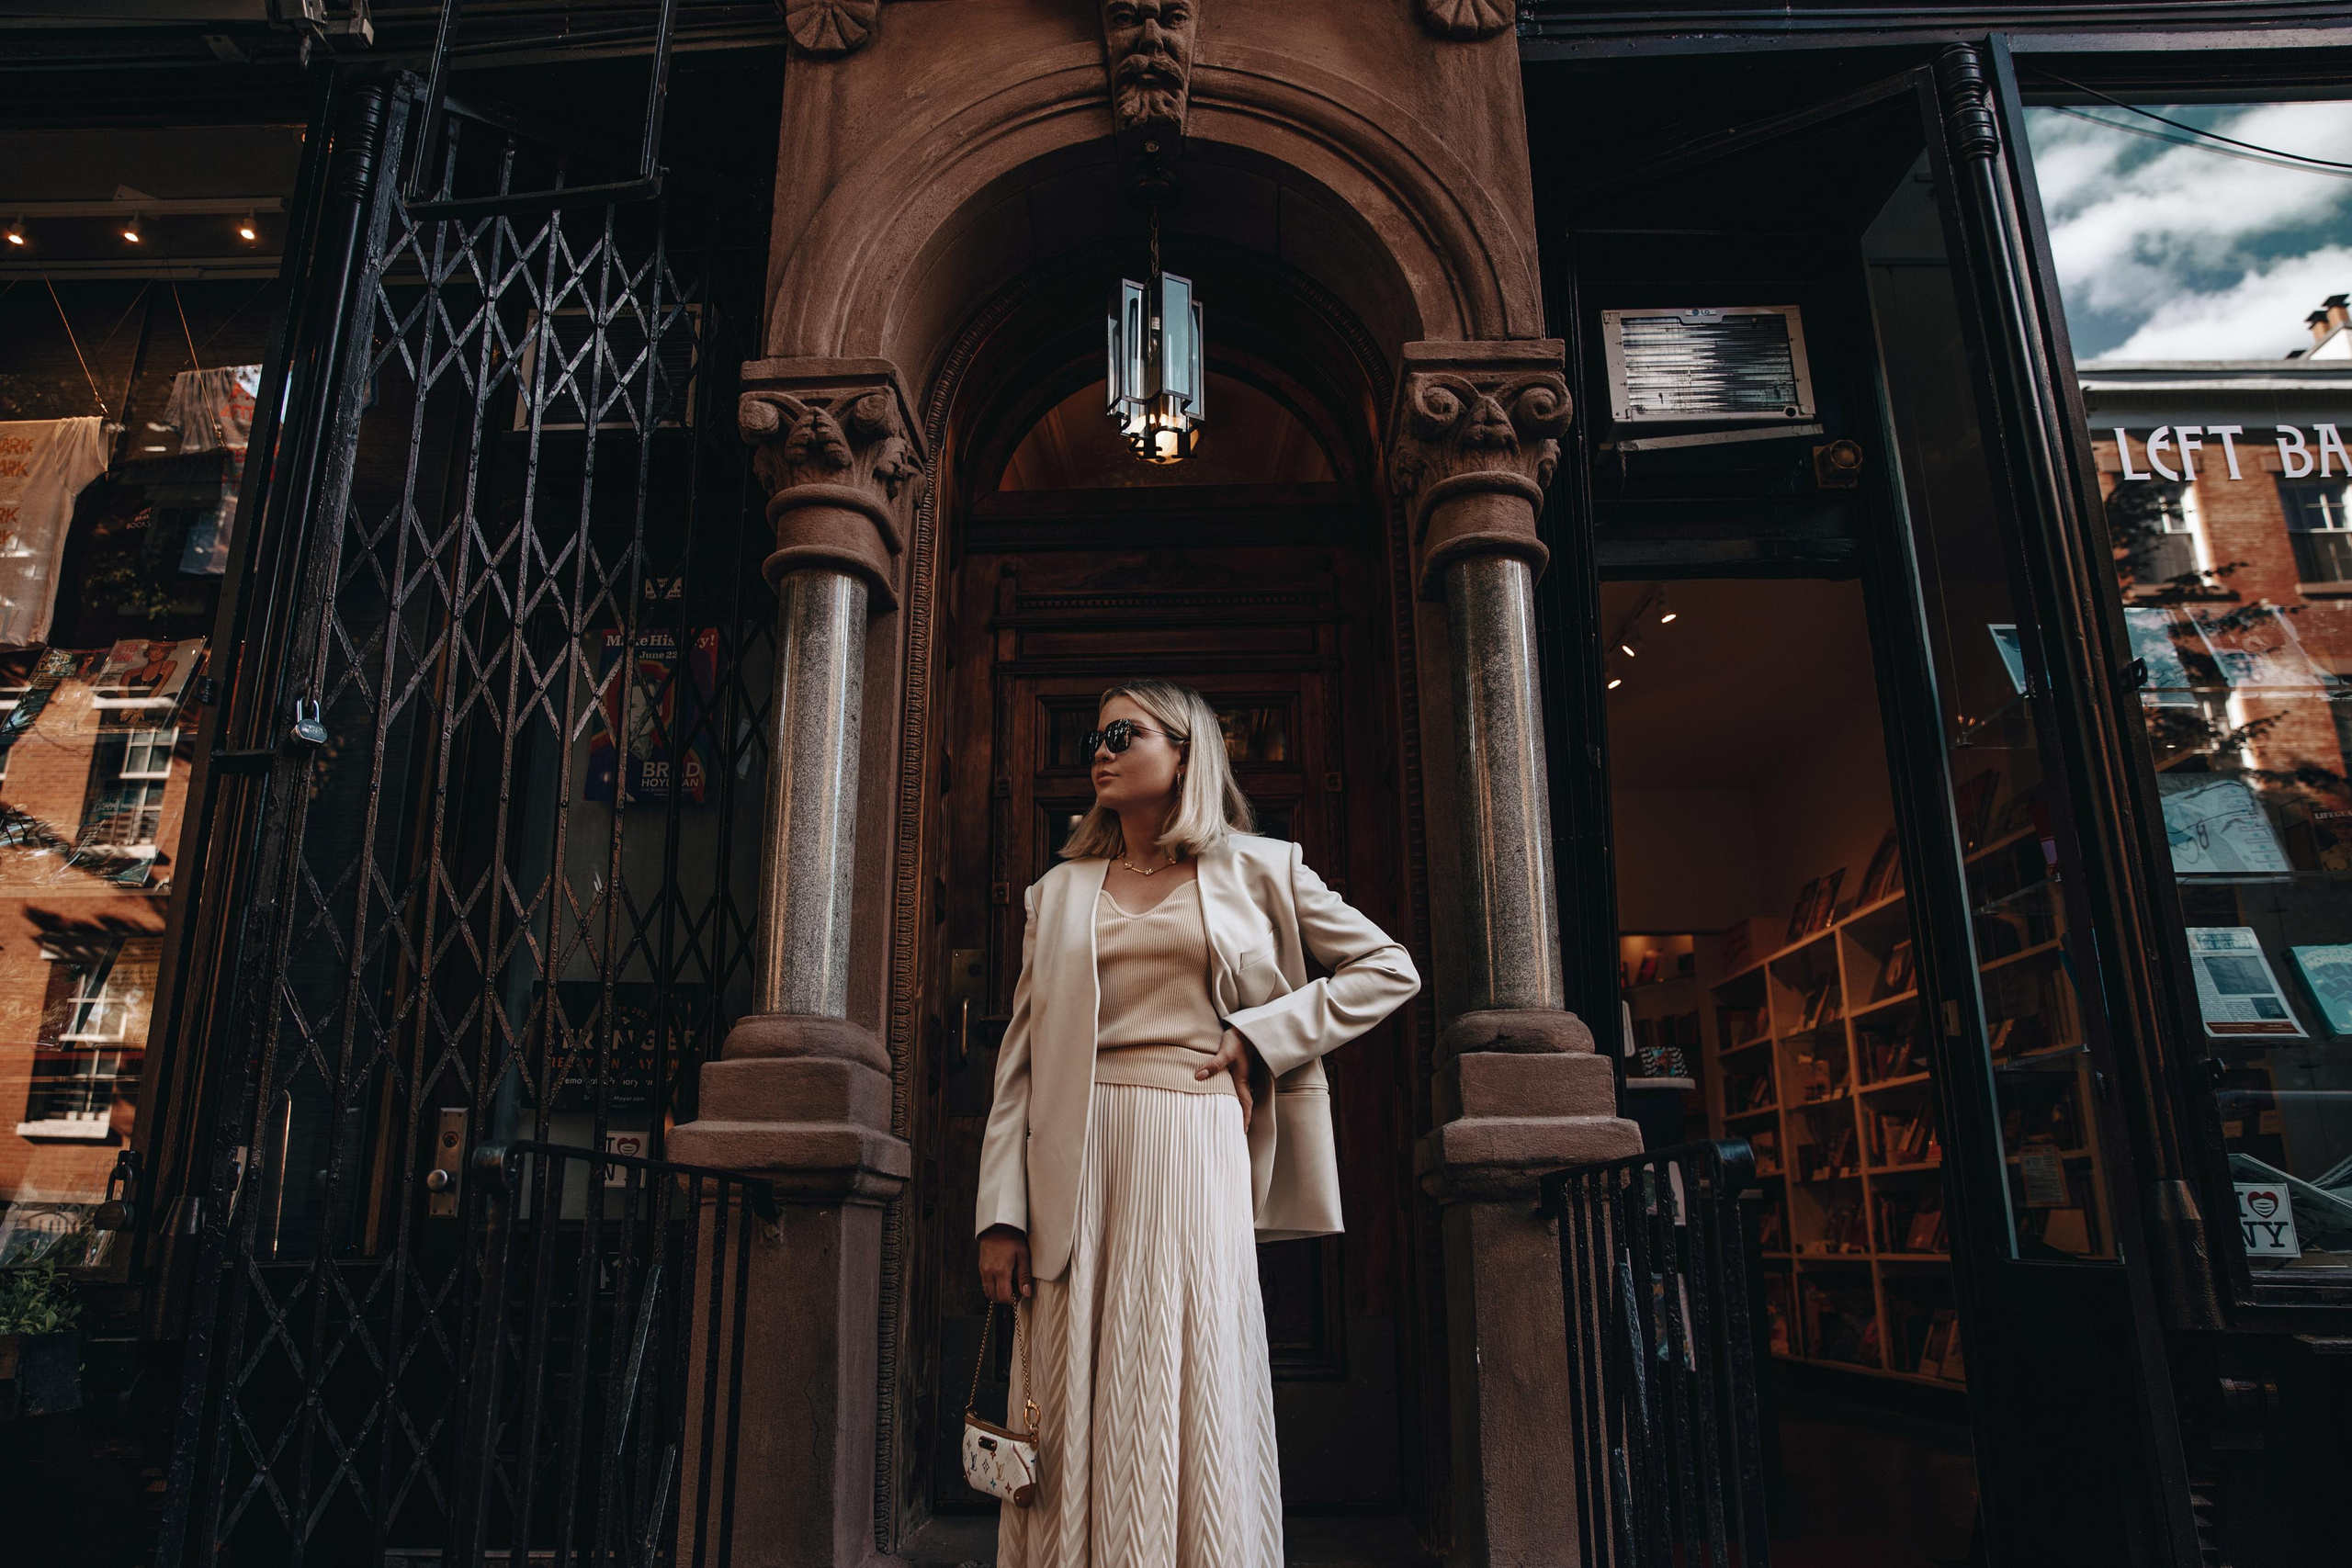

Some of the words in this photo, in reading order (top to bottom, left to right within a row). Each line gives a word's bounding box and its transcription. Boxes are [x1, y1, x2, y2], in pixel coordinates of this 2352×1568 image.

[2114, 424, 2244, 482] LEFT
[2276, 423, 2352, 479] BA
[639, 650, 664, 660] June
[642, 761, 701, 778] BRD
[2242, 1221, 2290, 1248] NY
